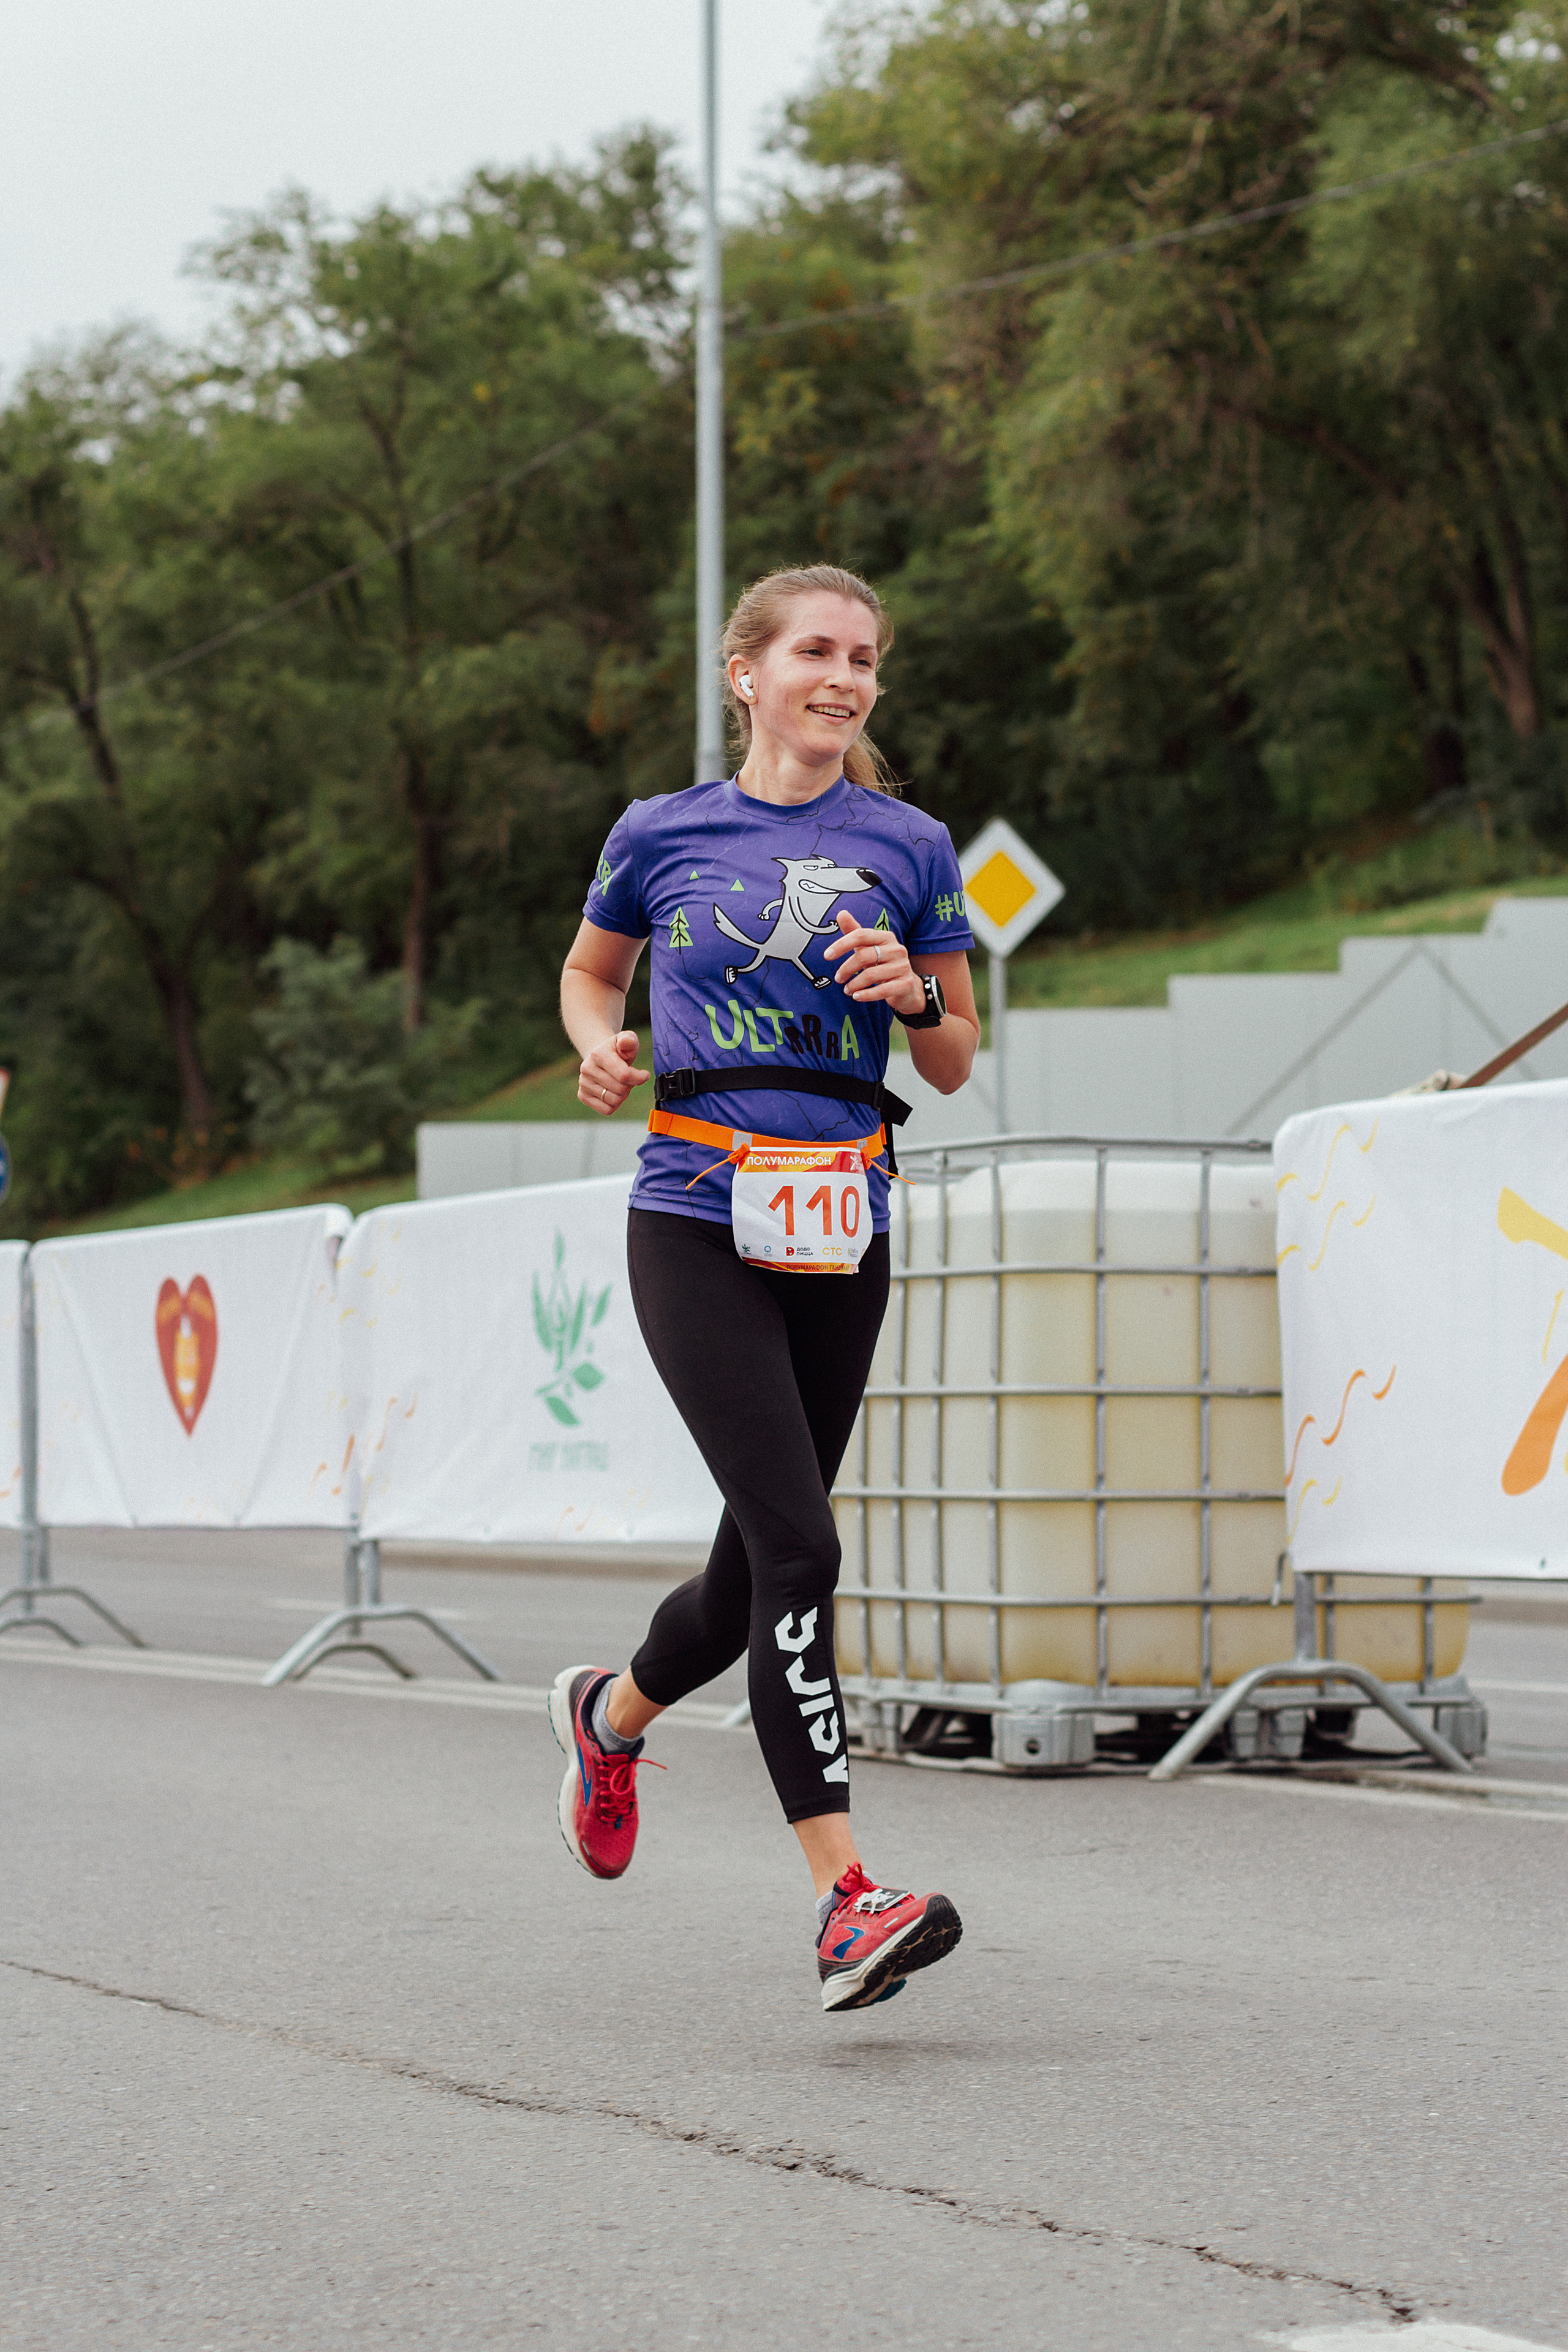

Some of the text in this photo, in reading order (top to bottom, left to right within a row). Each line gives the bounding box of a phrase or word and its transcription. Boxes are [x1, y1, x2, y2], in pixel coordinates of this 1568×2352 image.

[935, 890, 965, 922] #U
[704, 1000, 860, 1061] ULTRRRA
[747, 1156, 832, 1166] ПОЛУМАРАФОН
[768, 1185, 860, 1238] 110
